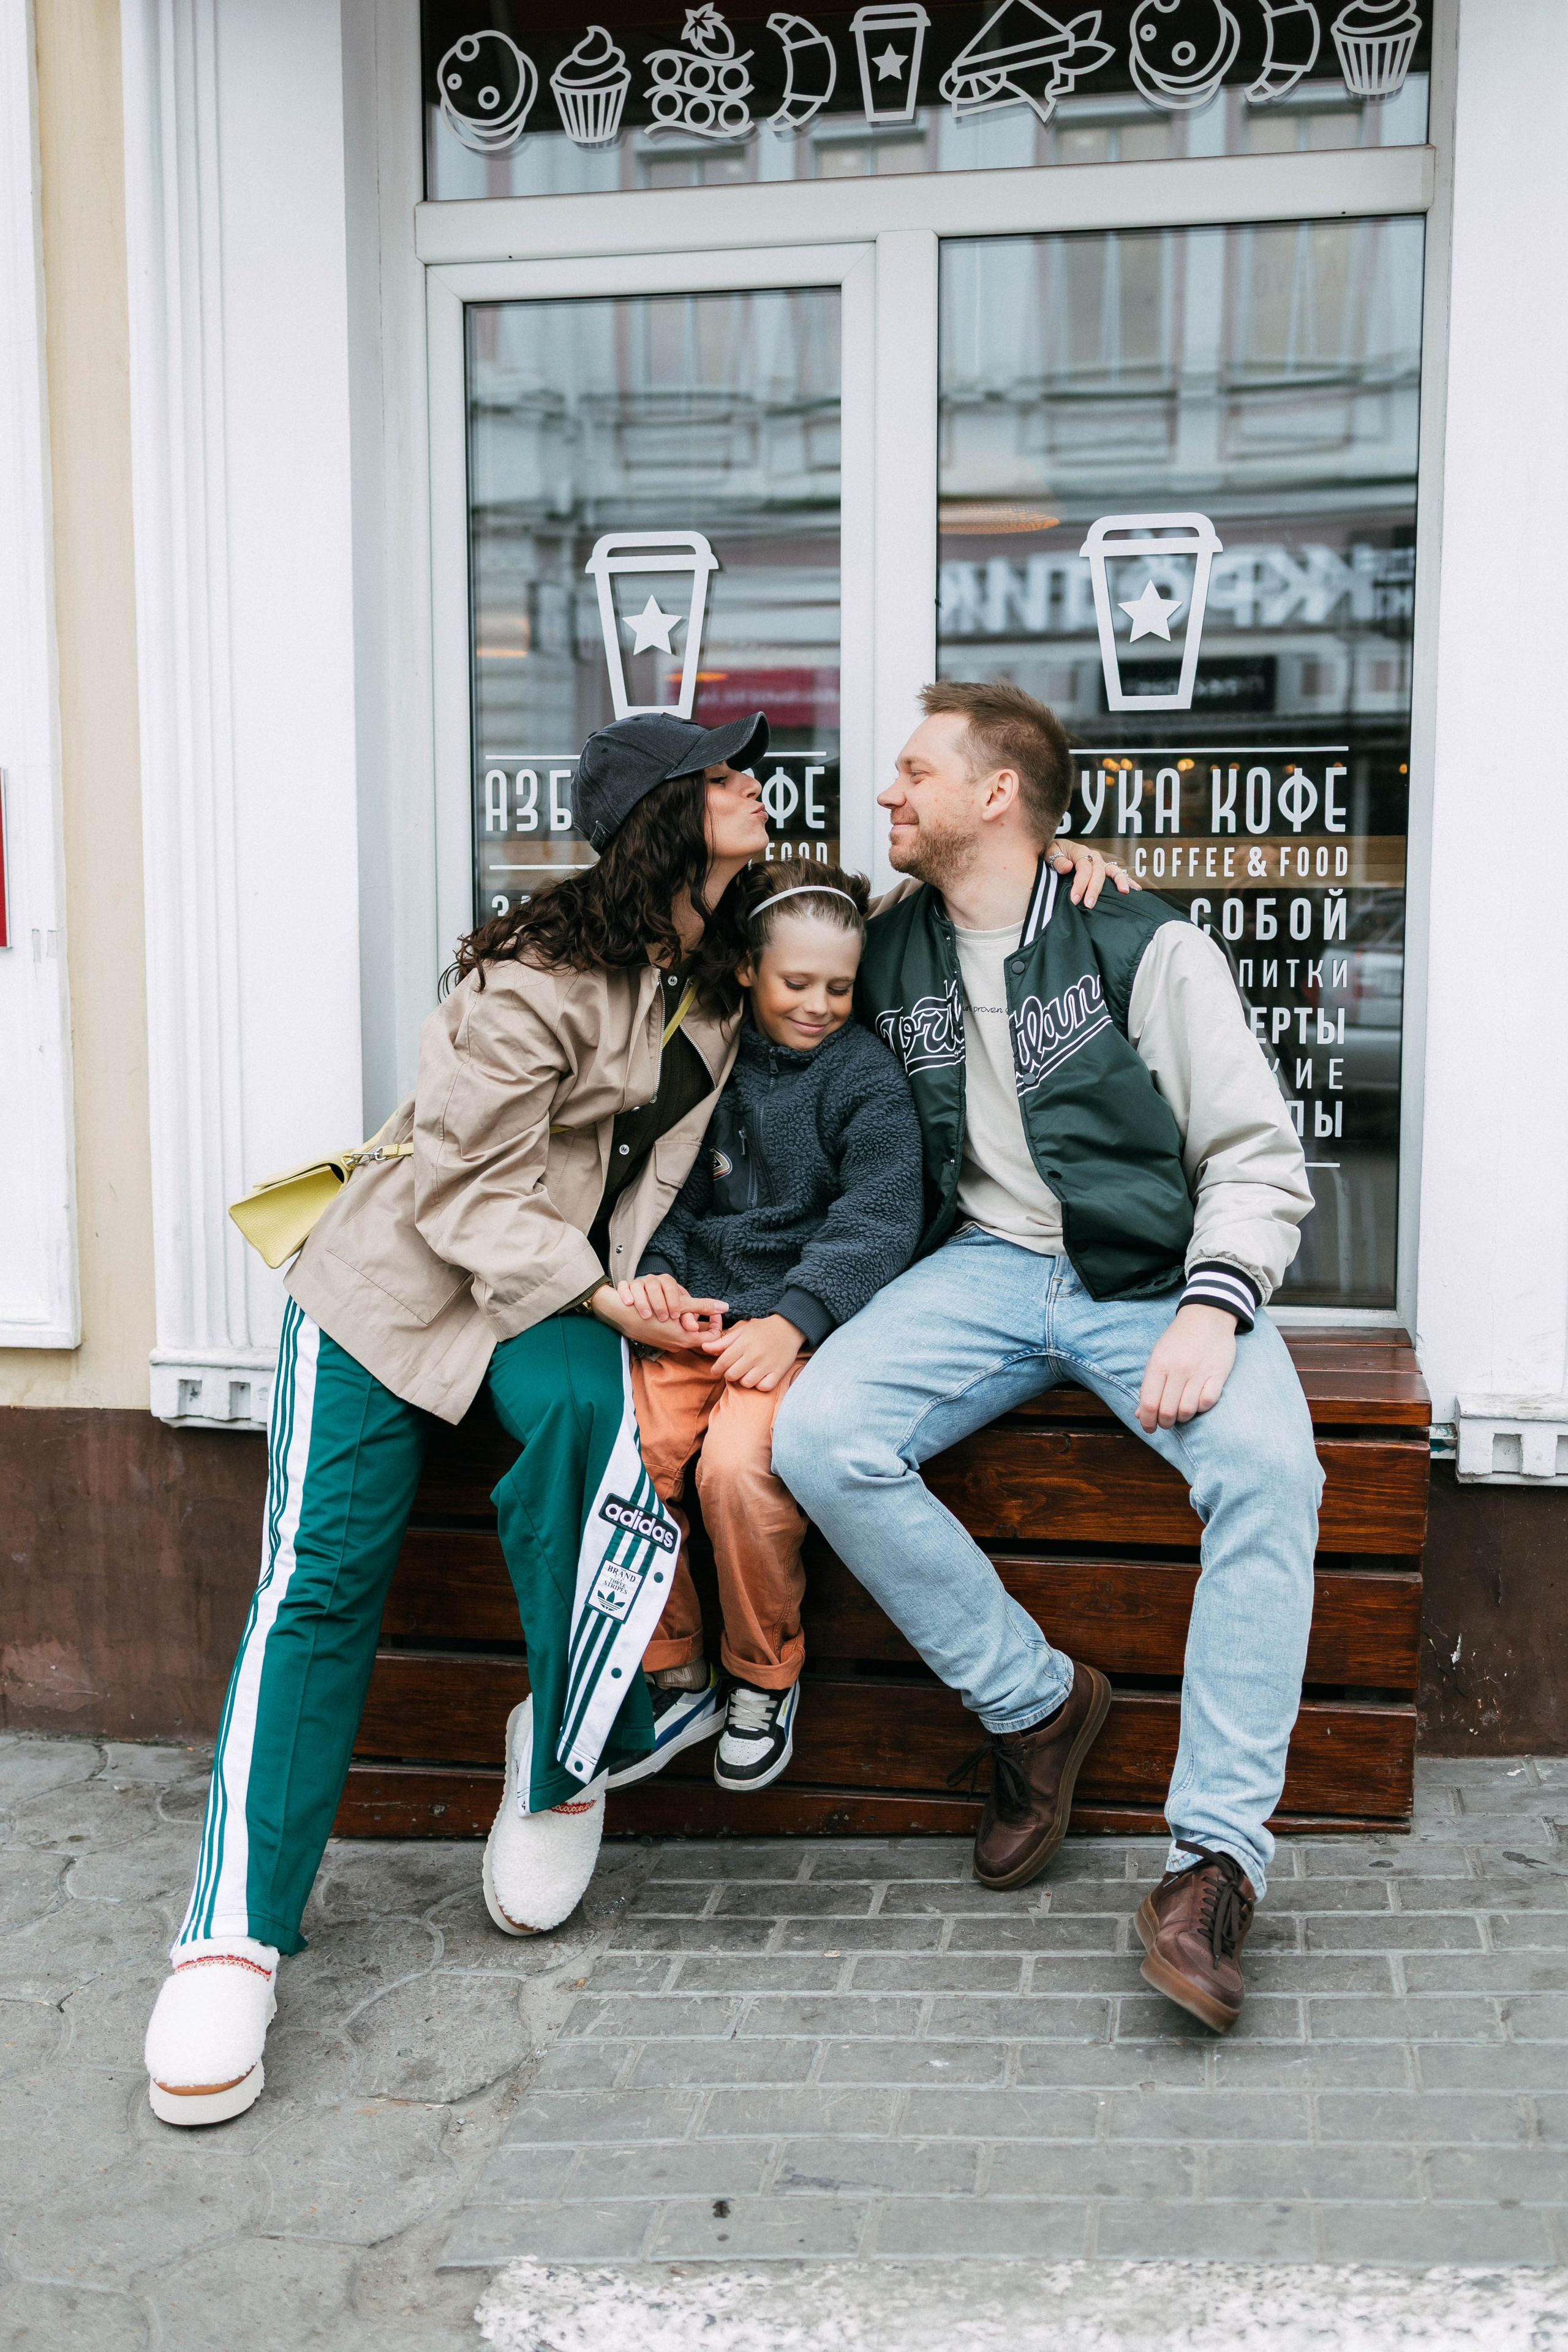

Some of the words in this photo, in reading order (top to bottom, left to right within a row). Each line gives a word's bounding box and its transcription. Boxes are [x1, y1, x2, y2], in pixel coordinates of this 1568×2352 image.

[485, 769, 572, 832] АЗБ
[742, 766, 825, 829] ФЕ
[1212, 766, 1347, 835] КОФЕ
[1135, 846, 1235, 878] COFFEE
[1248, 846, 1267, 877] &
[1280, 846, 1348, 876] FOOD
[1190, 888, 1347, 941] СОБОЙ
[1239, 959, 1348, 988] ПИТКИ
[1250, 1006, 1345, 1045] ЕРТЫ
[605, 1503, 674, 1548] adidas
[603, 1580, 628, 1595] STRIPES
[607, 1564, 636, 1582] BRAND
[609, 1577, 627, 1588] THREE
[664, 1667, 693, 1683] N
